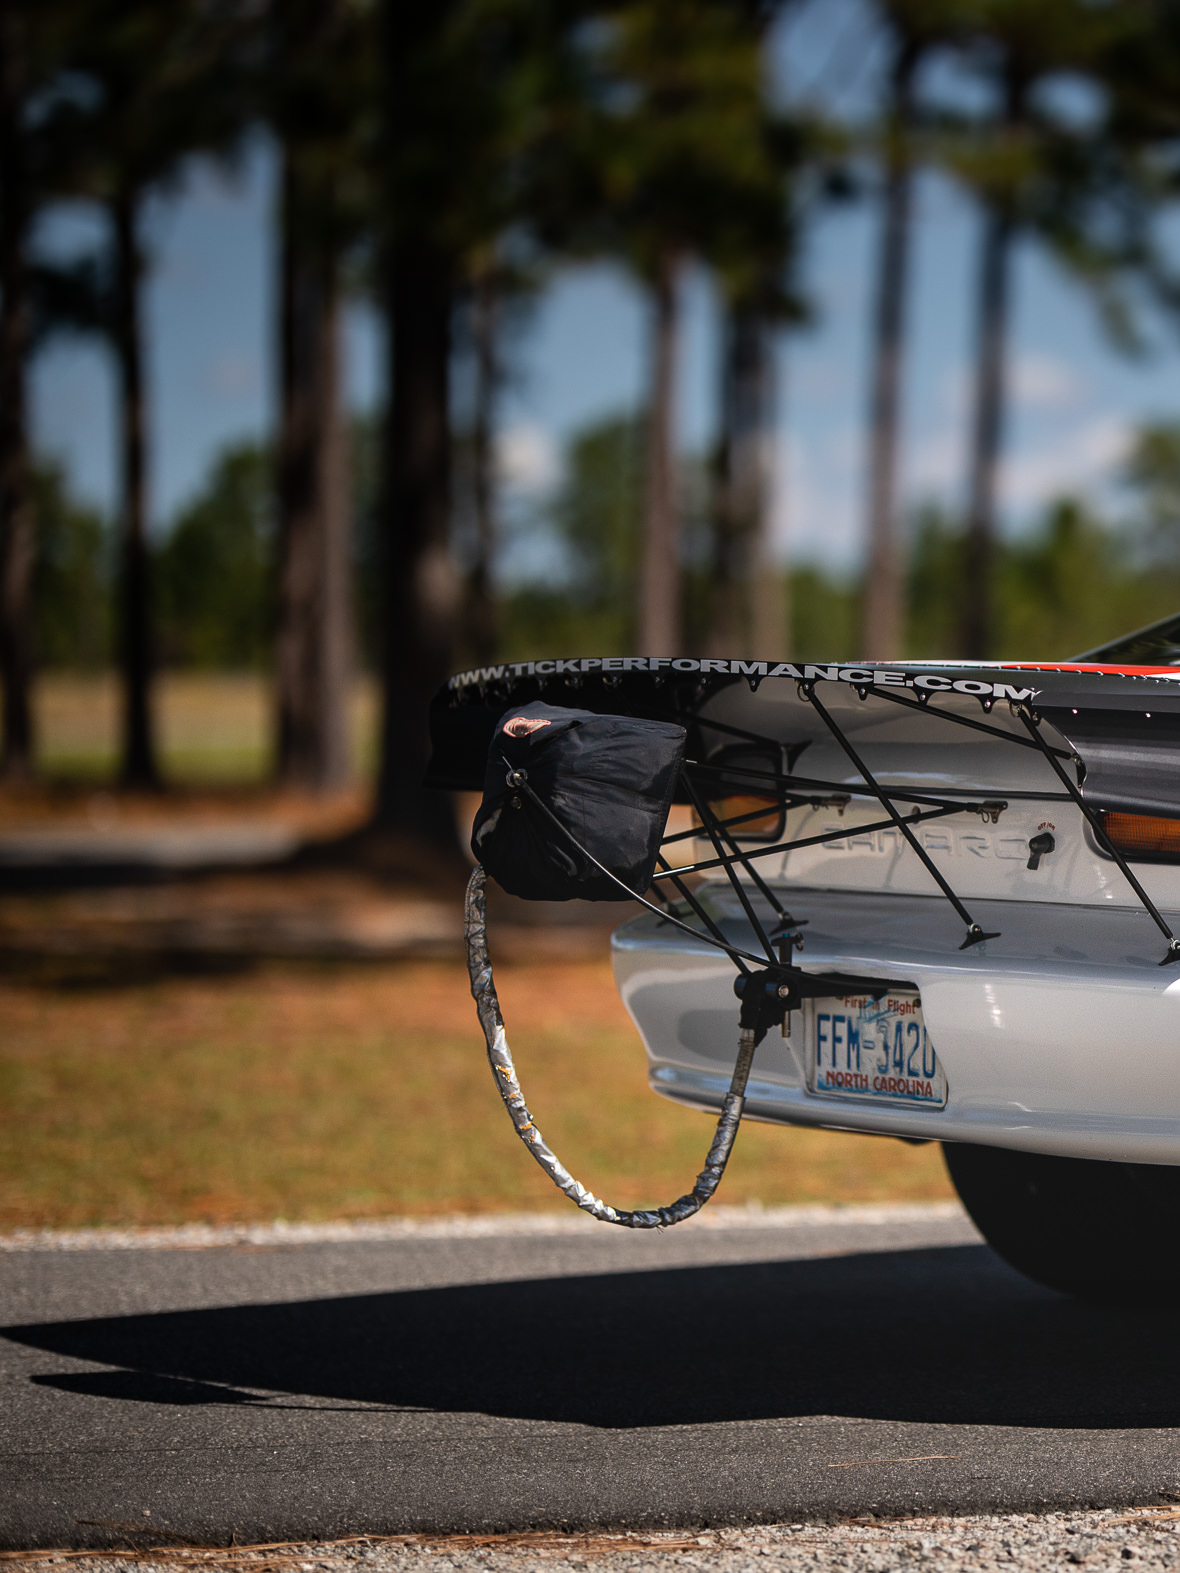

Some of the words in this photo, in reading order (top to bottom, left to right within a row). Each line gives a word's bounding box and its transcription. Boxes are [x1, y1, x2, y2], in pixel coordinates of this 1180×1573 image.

[448, 657, 1037, 701] WWW.TICKPERFORMANCE.COM
[844, 996, 867, 1010] First
[887, 999, 917, 1016] Flight
[826, 1071, 869, 1090] NORTH
[873, 1075, 934, 1098] CAROLINA
